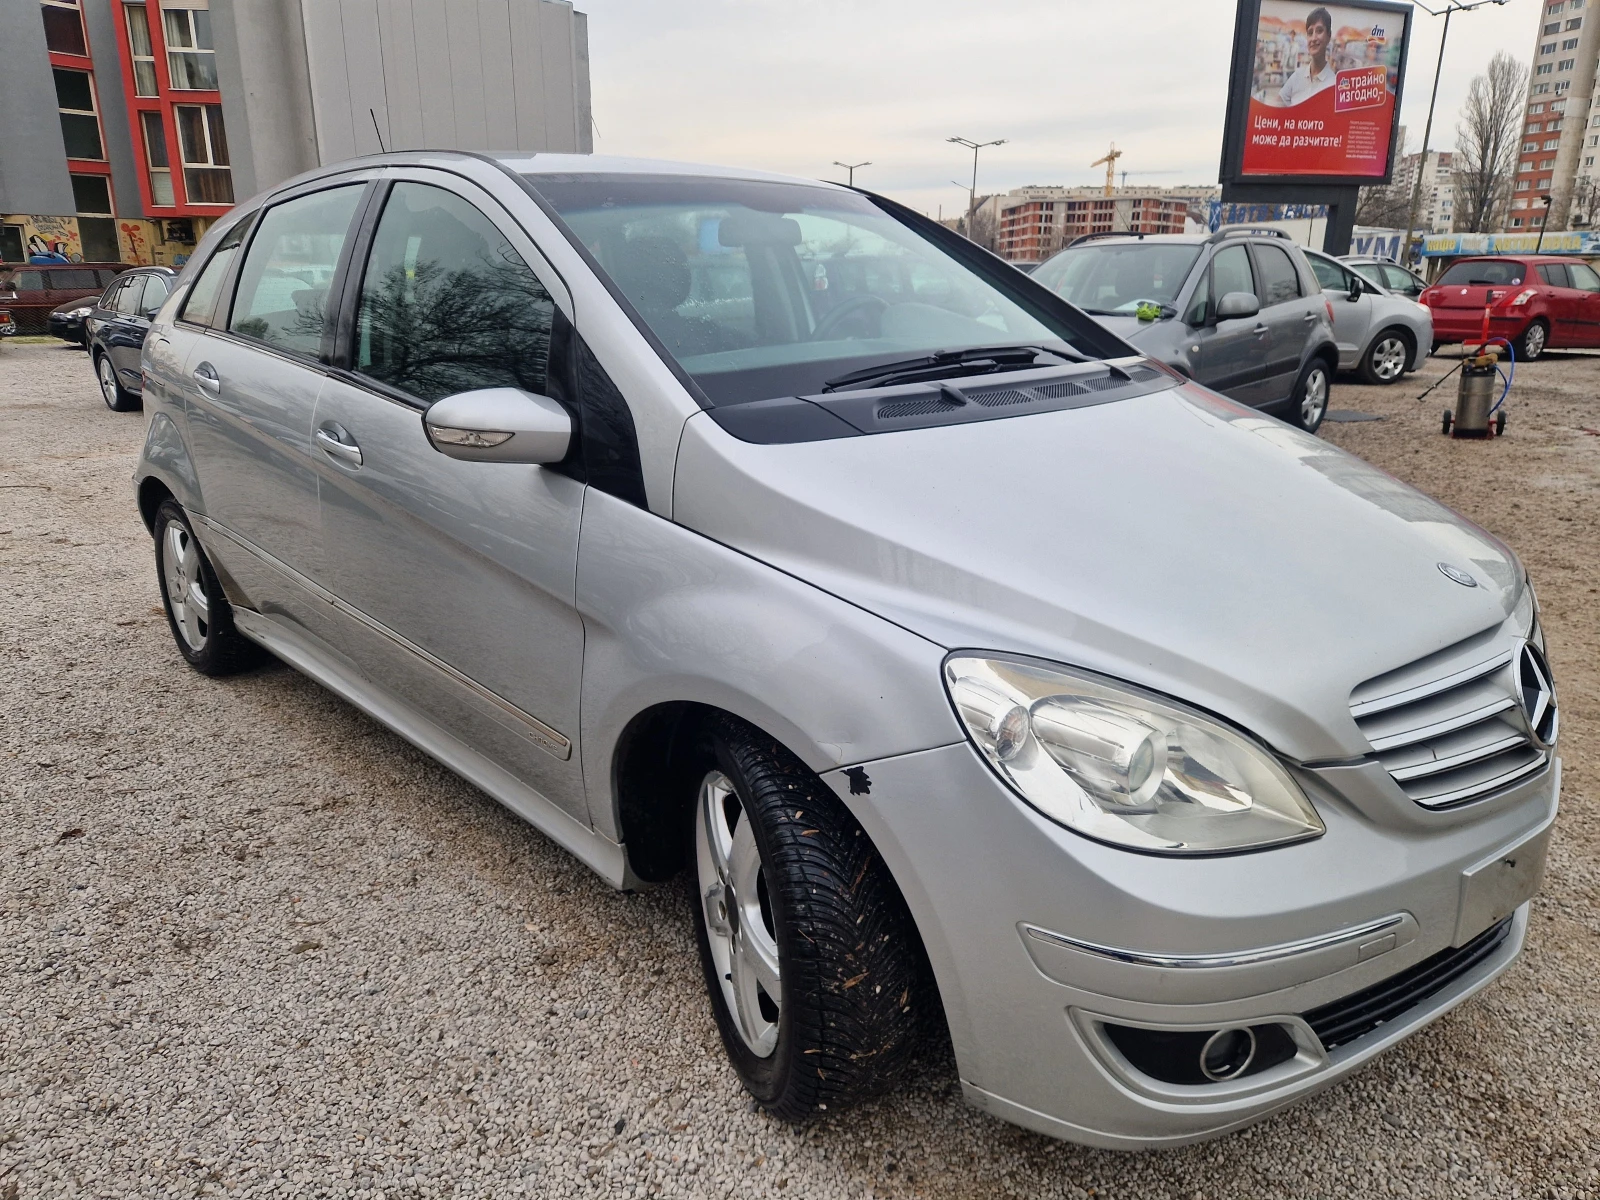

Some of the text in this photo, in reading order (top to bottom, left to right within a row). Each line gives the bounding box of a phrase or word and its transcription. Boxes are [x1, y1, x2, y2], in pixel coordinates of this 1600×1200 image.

[1371, 24, 1385, 36] dm
[1351, 71, 1385, 90] трайно
[1254, 115, 1324, 131] Цени, на които
[1252, 134, 1343, 149] може да разчитате!
